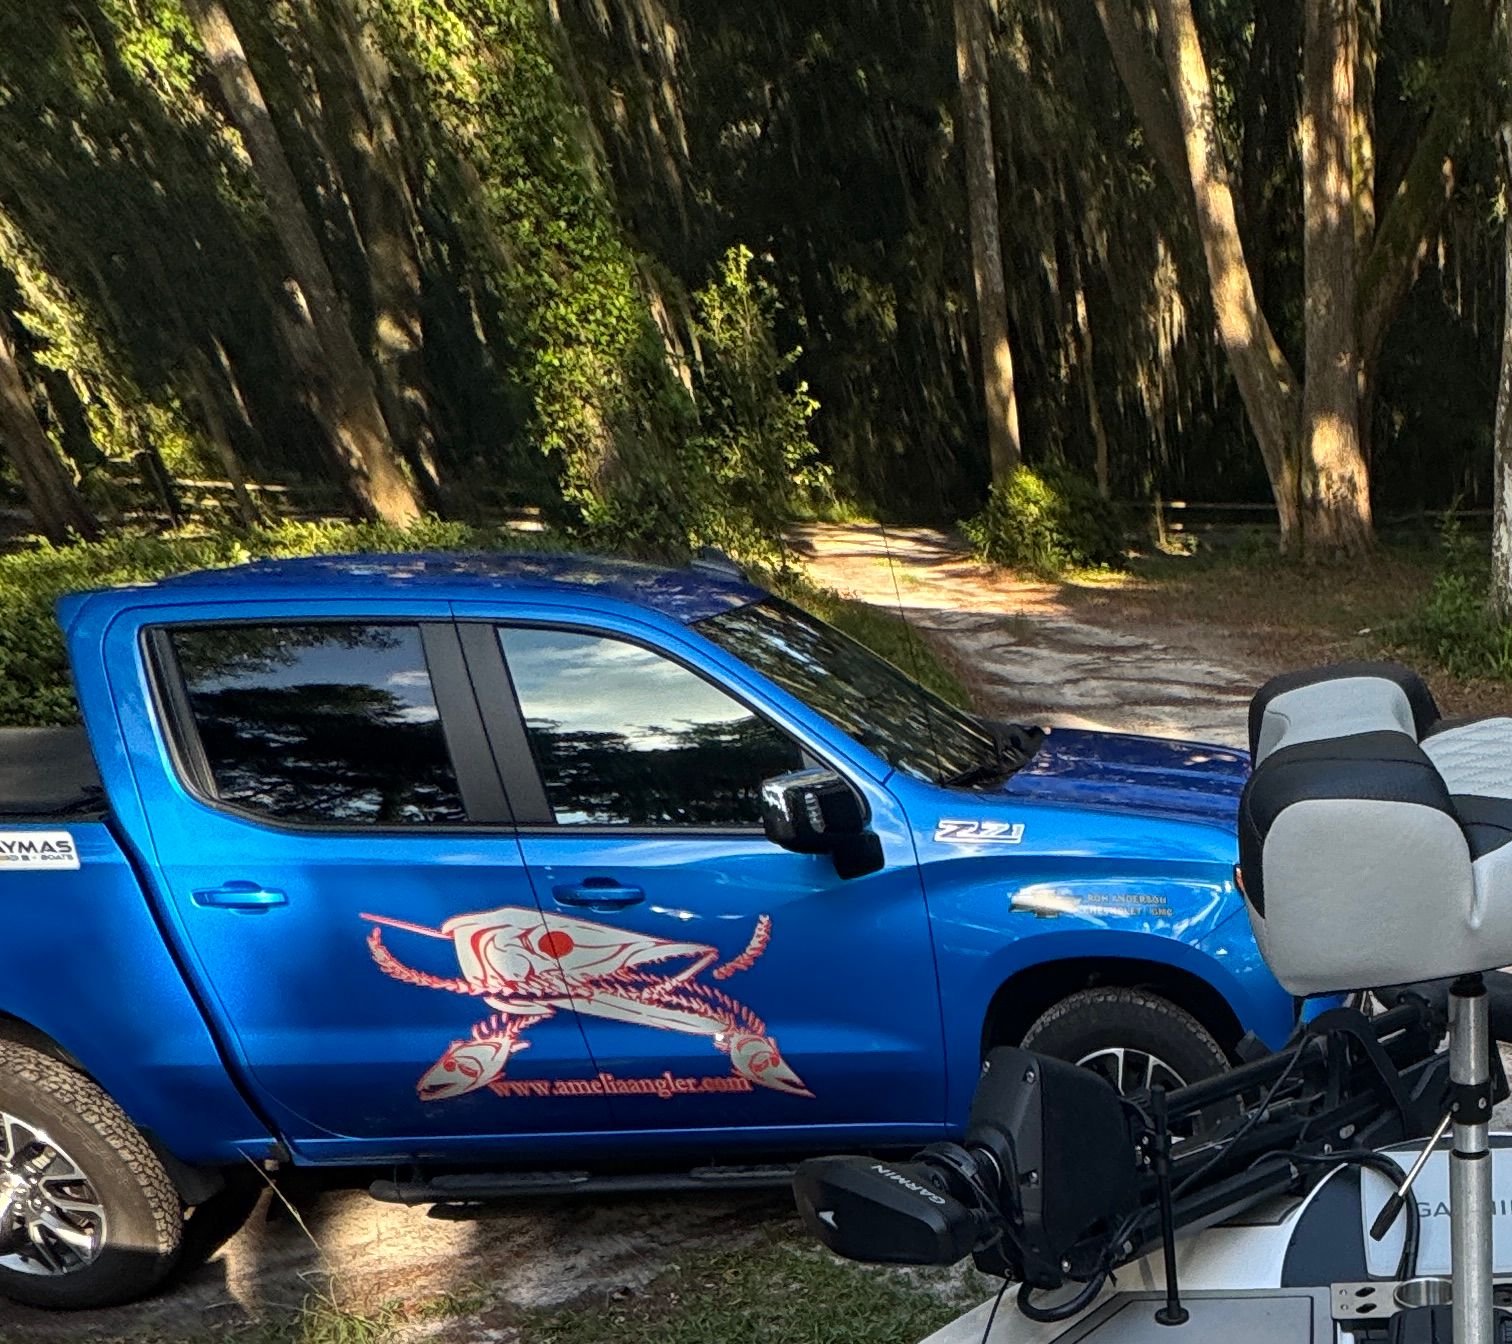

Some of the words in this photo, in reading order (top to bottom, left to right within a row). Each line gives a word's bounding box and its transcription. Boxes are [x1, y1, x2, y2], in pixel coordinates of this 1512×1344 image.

[934, 820, 1025, 844] Z71
[487, 1071, 753, 1099] www.ameliaangler.com
[871, 1165, 946, 1204] GARMIN
